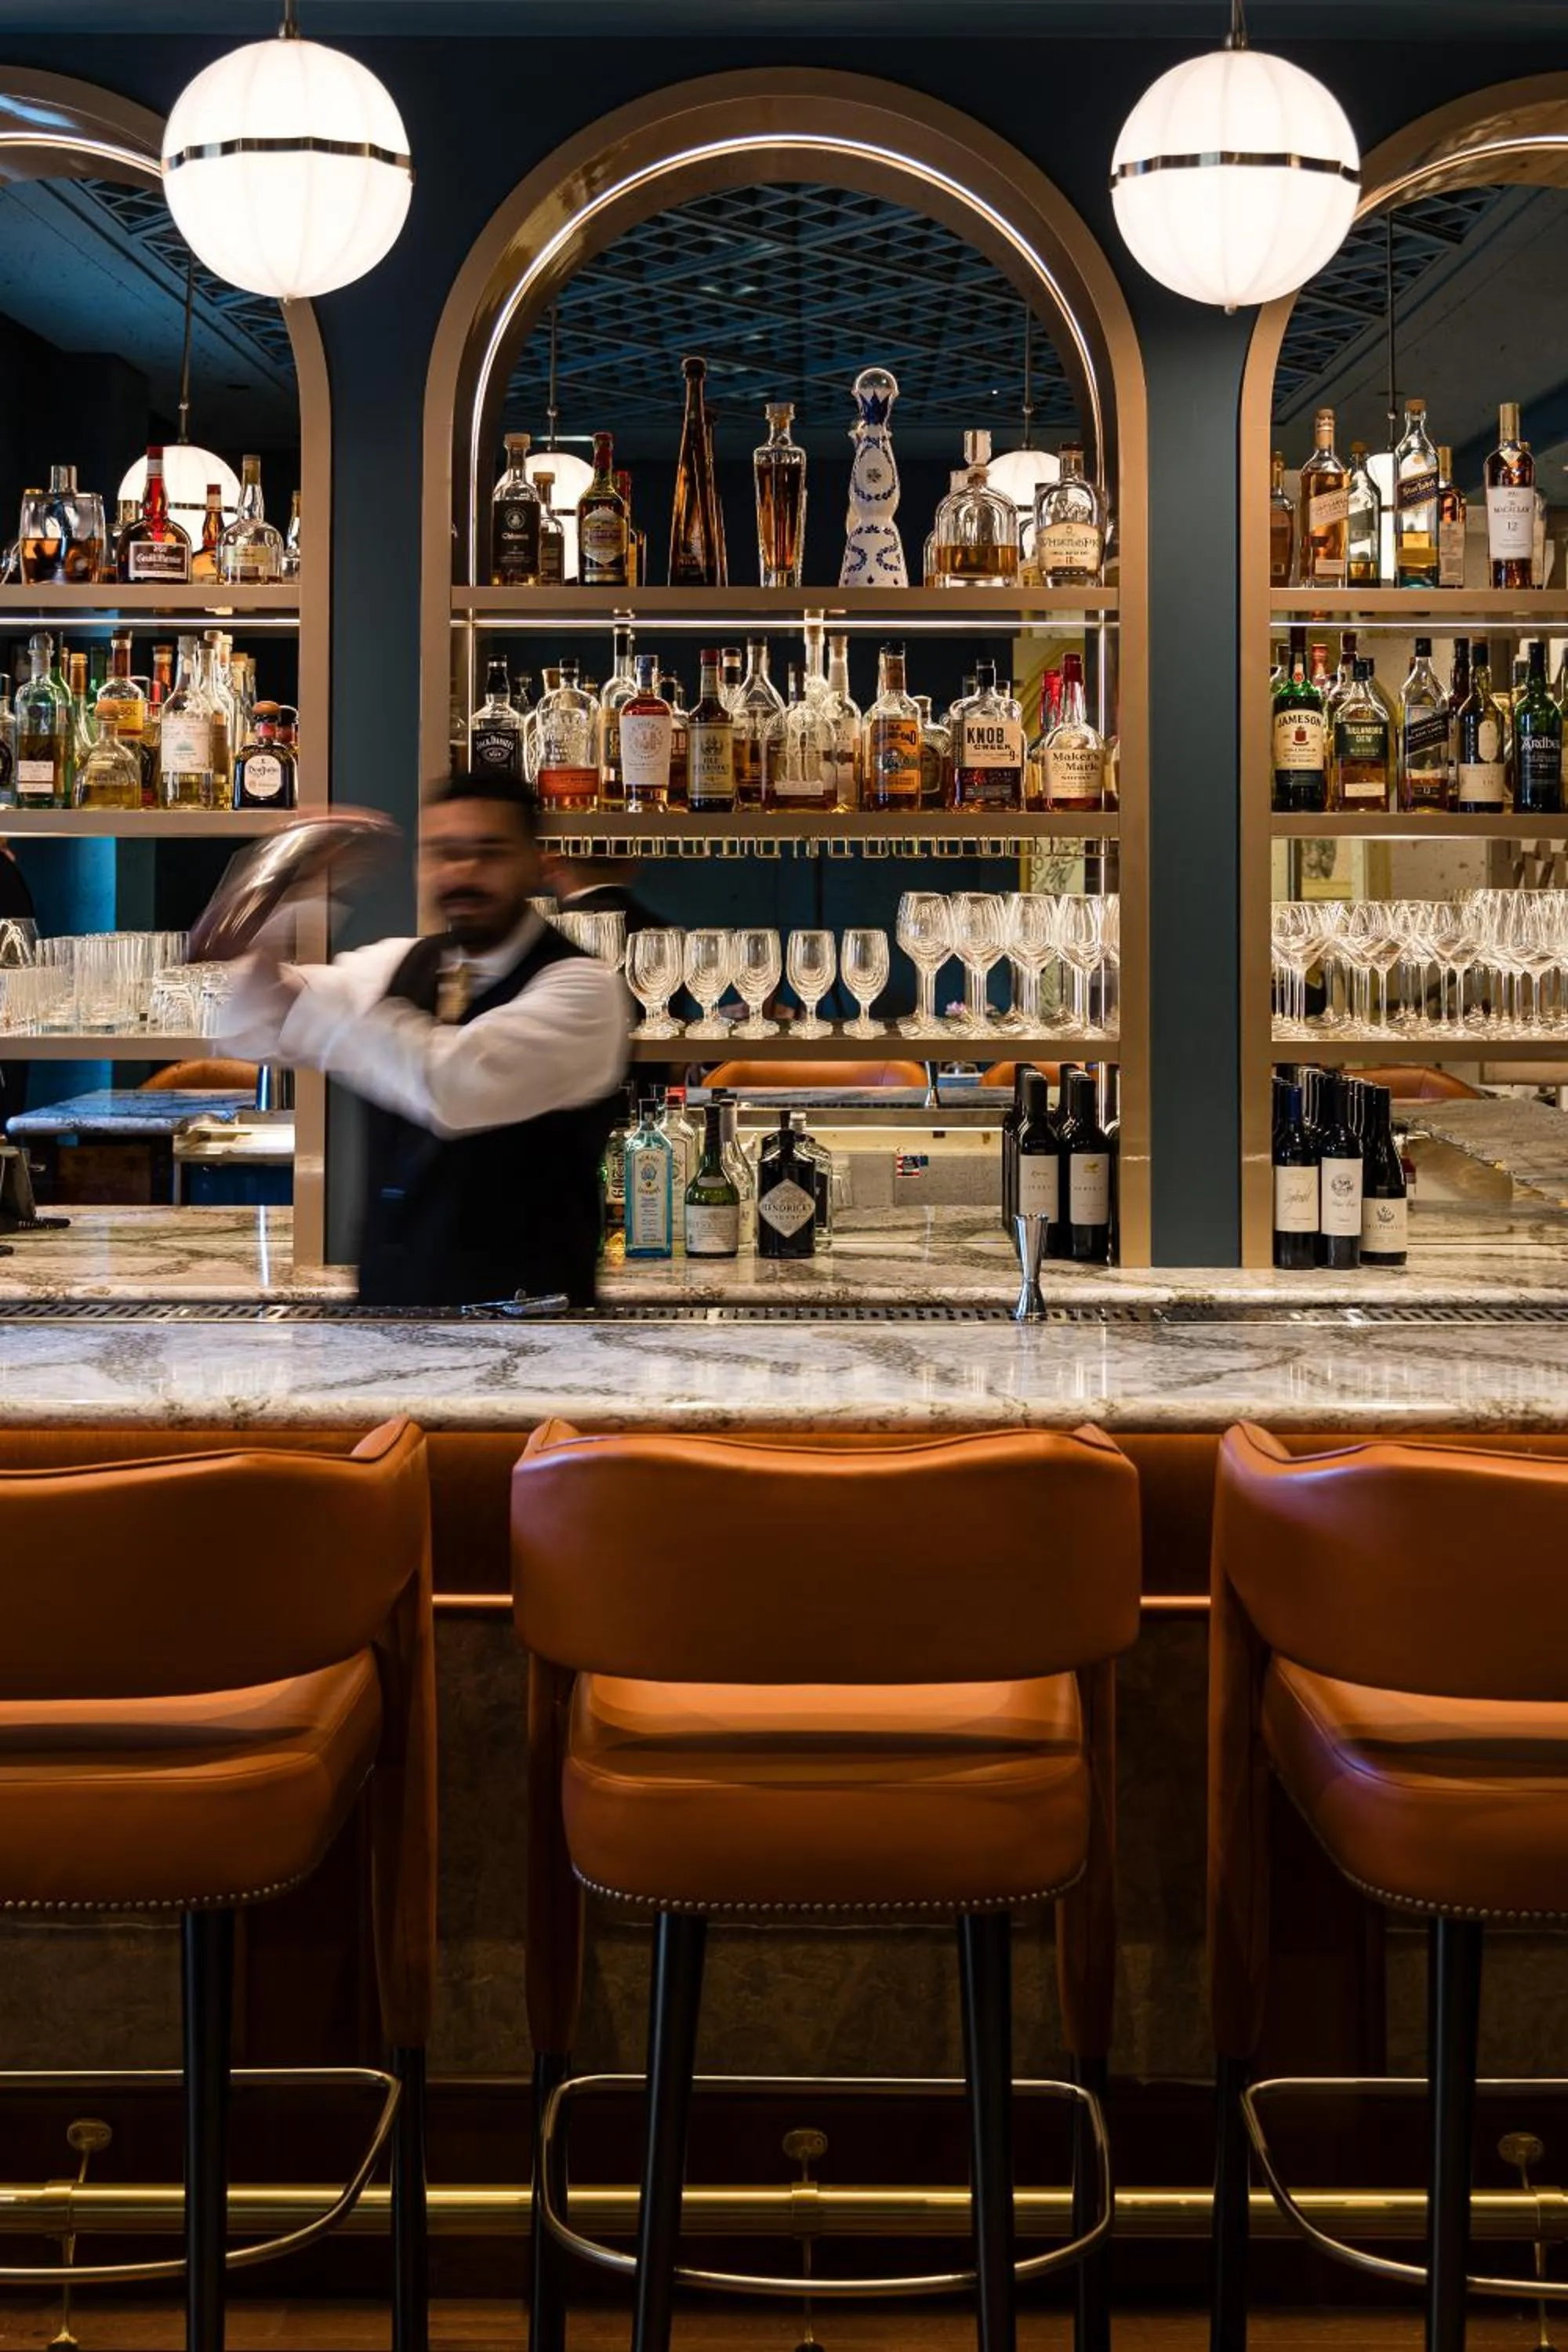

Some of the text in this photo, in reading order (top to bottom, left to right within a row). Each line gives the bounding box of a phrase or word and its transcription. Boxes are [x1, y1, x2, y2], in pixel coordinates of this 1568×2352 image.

[1507, 520, 1519, 532] 12
[1277, 713, 1322, 728] JAMESON
[967, 727, 1004, 743] KNOB
